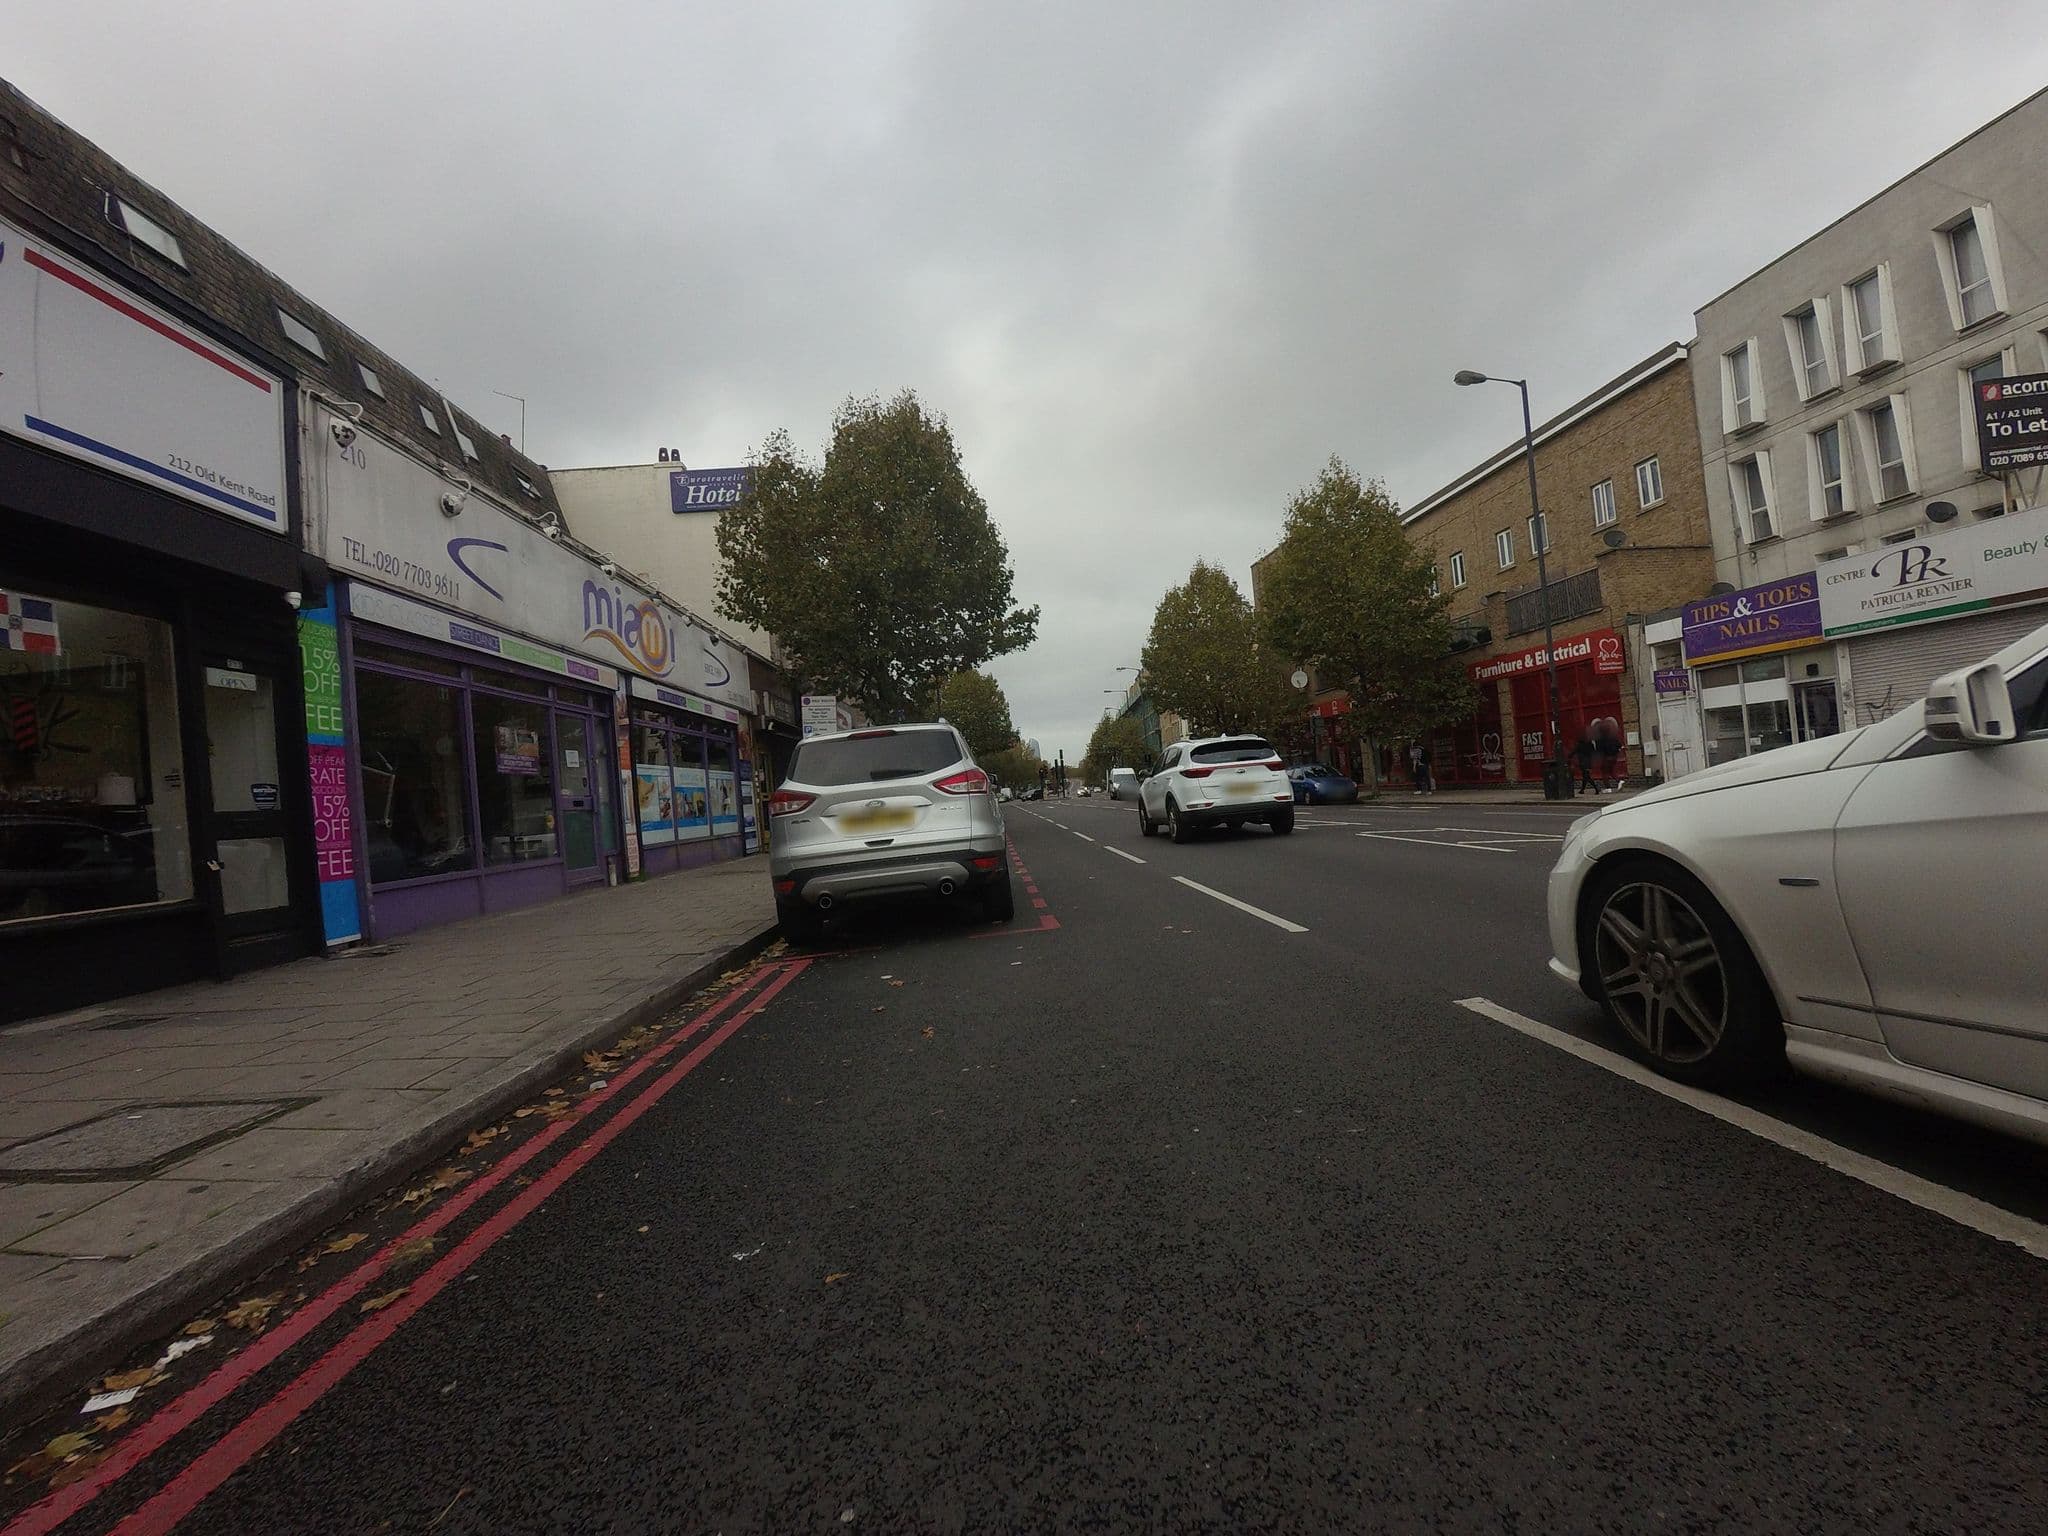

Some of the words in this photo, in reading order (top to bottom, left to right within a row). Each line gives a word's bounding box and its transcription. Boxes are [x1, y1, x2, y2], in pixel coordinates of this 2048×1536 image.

[1986, 412, 1998, 421] A1
[2008, 409, 2021, 418] A2
[2022, 406, 2044, 417] Unit
[1986, 422, 2013, 438] To
[2017, 416, 2048, 434] Let
[1990, 456, 2009, 467] 020
[2011, 452, 2035, 465] 7089
[167, 453, 193, 475] 212
[194, 464, 217, 485] Old
[218, 475, 246, 497] Kent
[247, 485, 277, 508] Road
[1984, 540, 2041, 562] Beauty
[403, 560, 432, 590] 7703
[434, 573, 461, 601] 9811
[1826, 568, 1867, 587] CENTRE
[1690, 601, 1731, 624] TIPS
[1732, 597, 1754, 619] &
[1755, 581, 1812, 608] TOES
[1860, 590, 1914, 611] PATRICIA
[1916, 578, 1974, 598] REYNIER
[1719, 613, 1781, 641] NAILS
[300, 645, 341, 672] 15%
[1474, 658, 1523, 680] Furniture
[1524, 654, 1533, 668] &
[1535, 638, 1591, 667] Electrical
[220, 677, 248, 689] OPEN
[303, 669, 341, 695] OFF
[1659, 677, 1688, 690] NAILS
[305, 702, 344, 732] FEE
[1521, 731, 1544, 746] FAST
[309, 767, 346, 785] RATE
[311, 795, 351, 818] 15%
[314, 818, 351, 842] OFF
[316, 849, 355, 880] FEE
